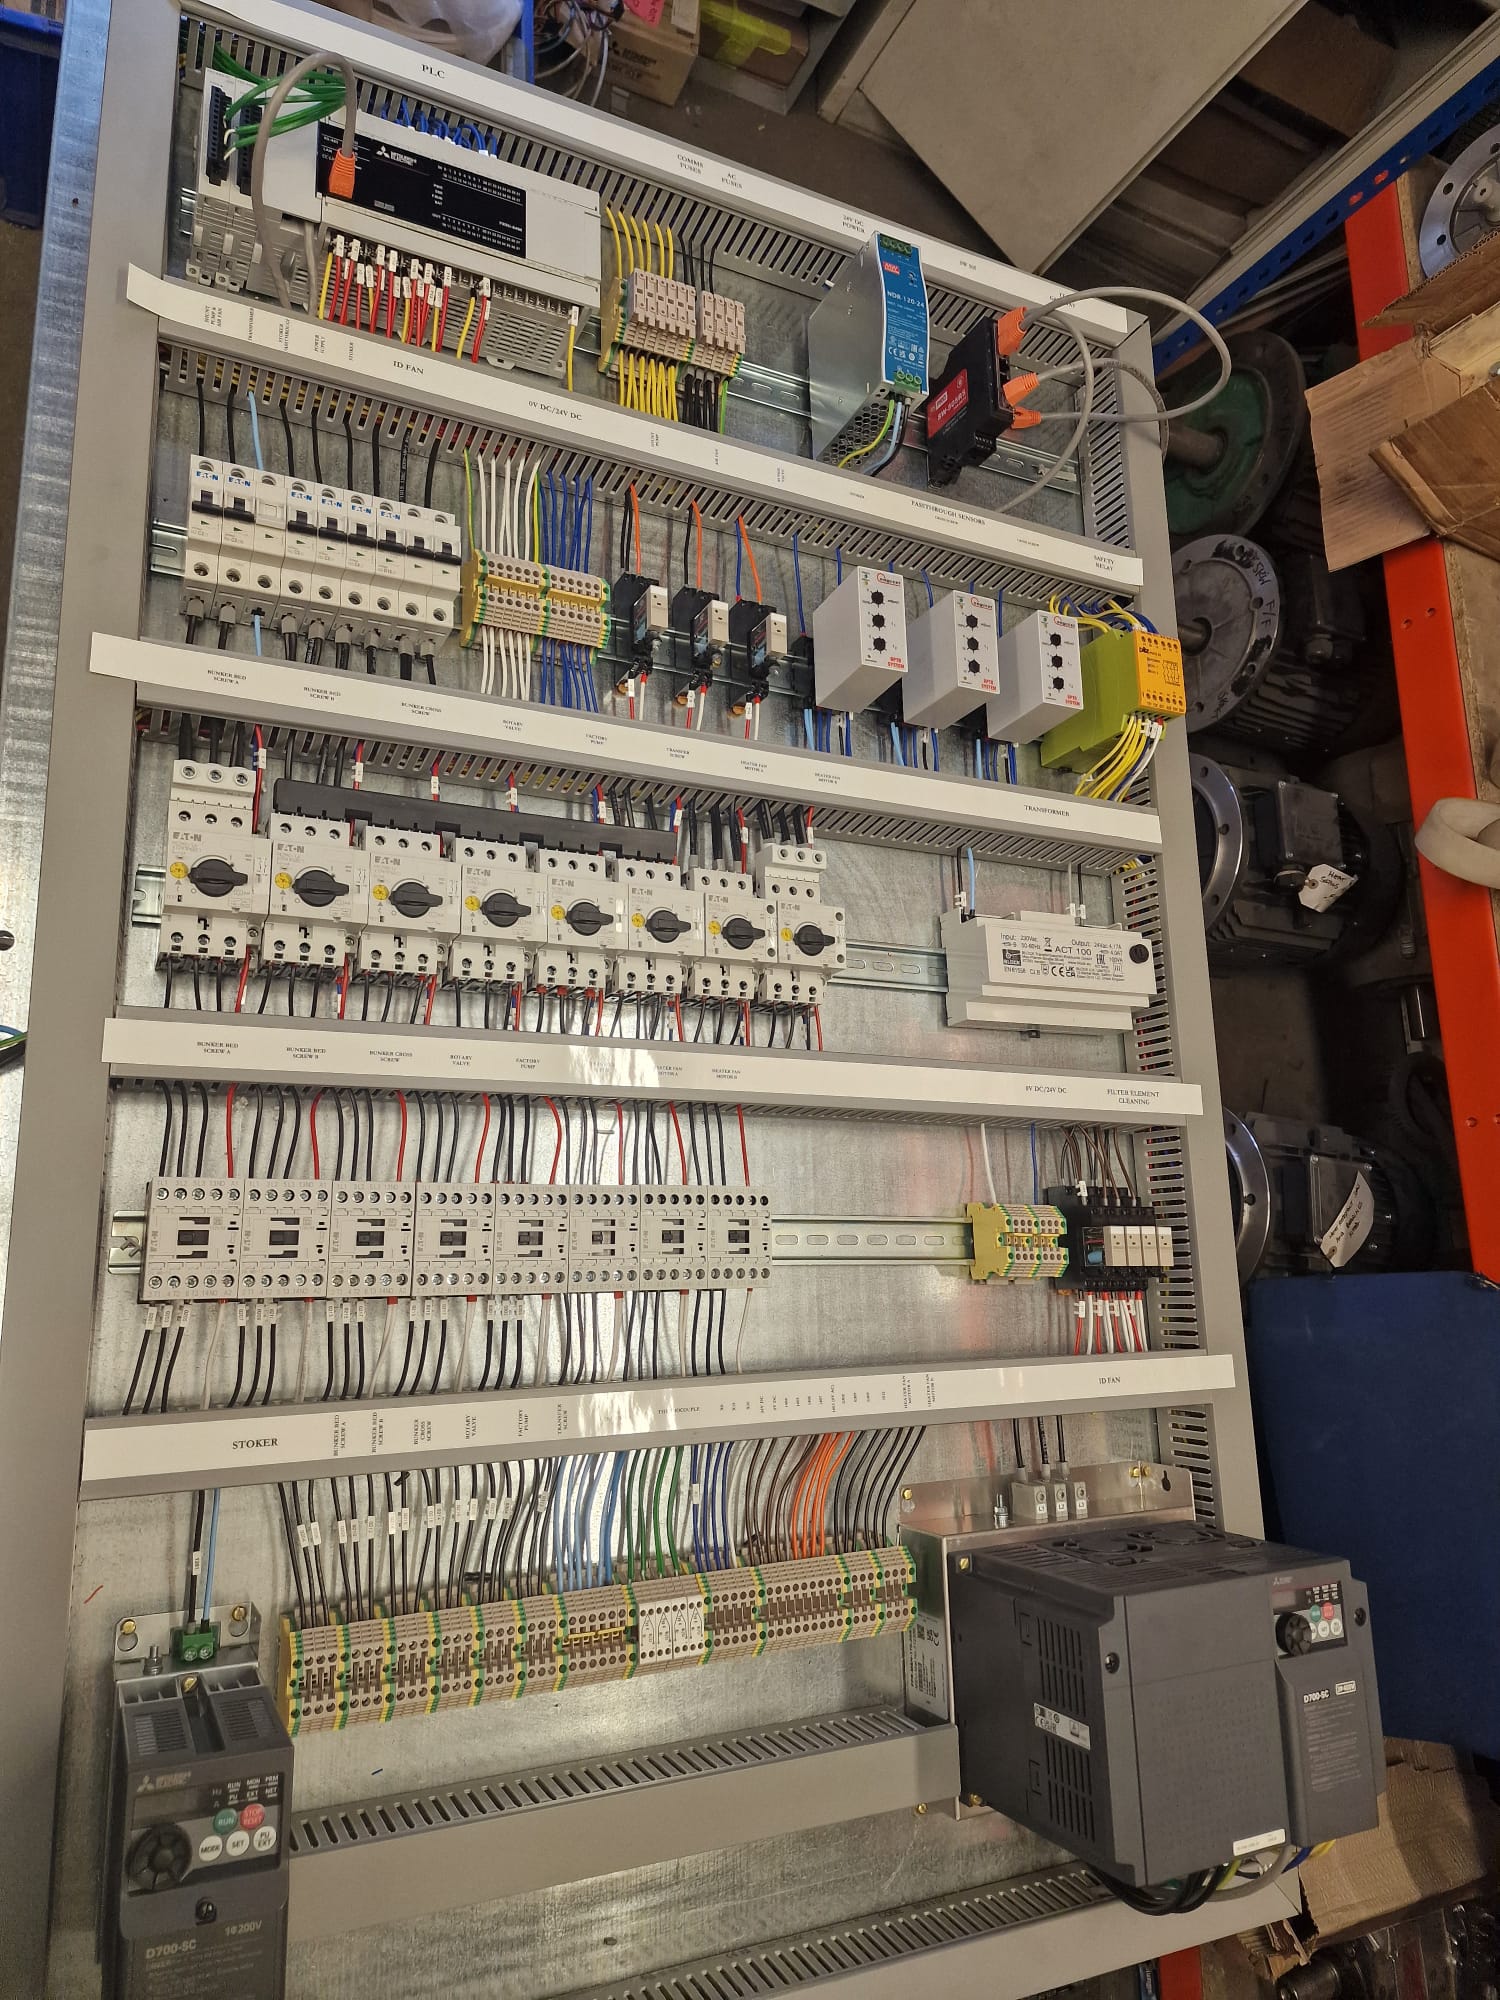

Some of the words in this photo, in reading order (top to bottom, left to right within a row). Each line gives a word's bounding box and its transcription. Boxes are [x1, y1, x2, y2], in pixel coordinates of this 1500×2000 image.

[421, 63, 446, 79] PLC
[677, 154, 704, 168] COMMS
[680, 162, 702, 174] FUSES
[727, 172, 736, 180] AC
[721, 177, 743, 189] FUSES
[842, 221, 865, 233] POWER
[393, 360, 403, 370] ID
[406, 363, 424, 375] FAN
[528, 401, 538, 409] 0V
[540, 404, 569, 417] DC/24V
[570, 412, 583, 421] DC
[958, 513, 986, 526] SENSORS
[1093, 555, 1115, 565] SAFETY
[1095, 562, 1113, 572] RELAY
[208, 669, 233, 678] BUNKER
[214, 676, 235, 684] SCREW
[304, 686, 328, 695] BUNKER
[310, 693, 329, 701] SCREW
[401, 702, 425, 710] BUNKER
[666, 747, 690, 755] TRANSFER
[1024, 804, 1070, 817] TRANSFORMER
[1055, 945, 1072, 954] ACT
[1130, 1089, 1160, 1098] ELEMENT
[1099, 1377, 1106, 1385] ID
[1107, 1376, 1121, 1384] FAN
[232, 1438, 278, 1450] STOKER
[1304, 1690, 1329, 1703] D700-SC
[227, 1781, 241, 1789] RUN
[246, 1778, 260, 1786] MON
[265, 1775, 279, 1783] PRM
[246, 1790, 258, 1798] EXT
[265, 1787, 277, 1795] NET
[218, 1817, 235, 1826] RUN
[232, 1840, 245, 1849] SET
[258, 1839, 271, 1847] EXT
[200, 1844, 220, 1854] MODE
[145, 1939, 197, 1959] D700-SC
